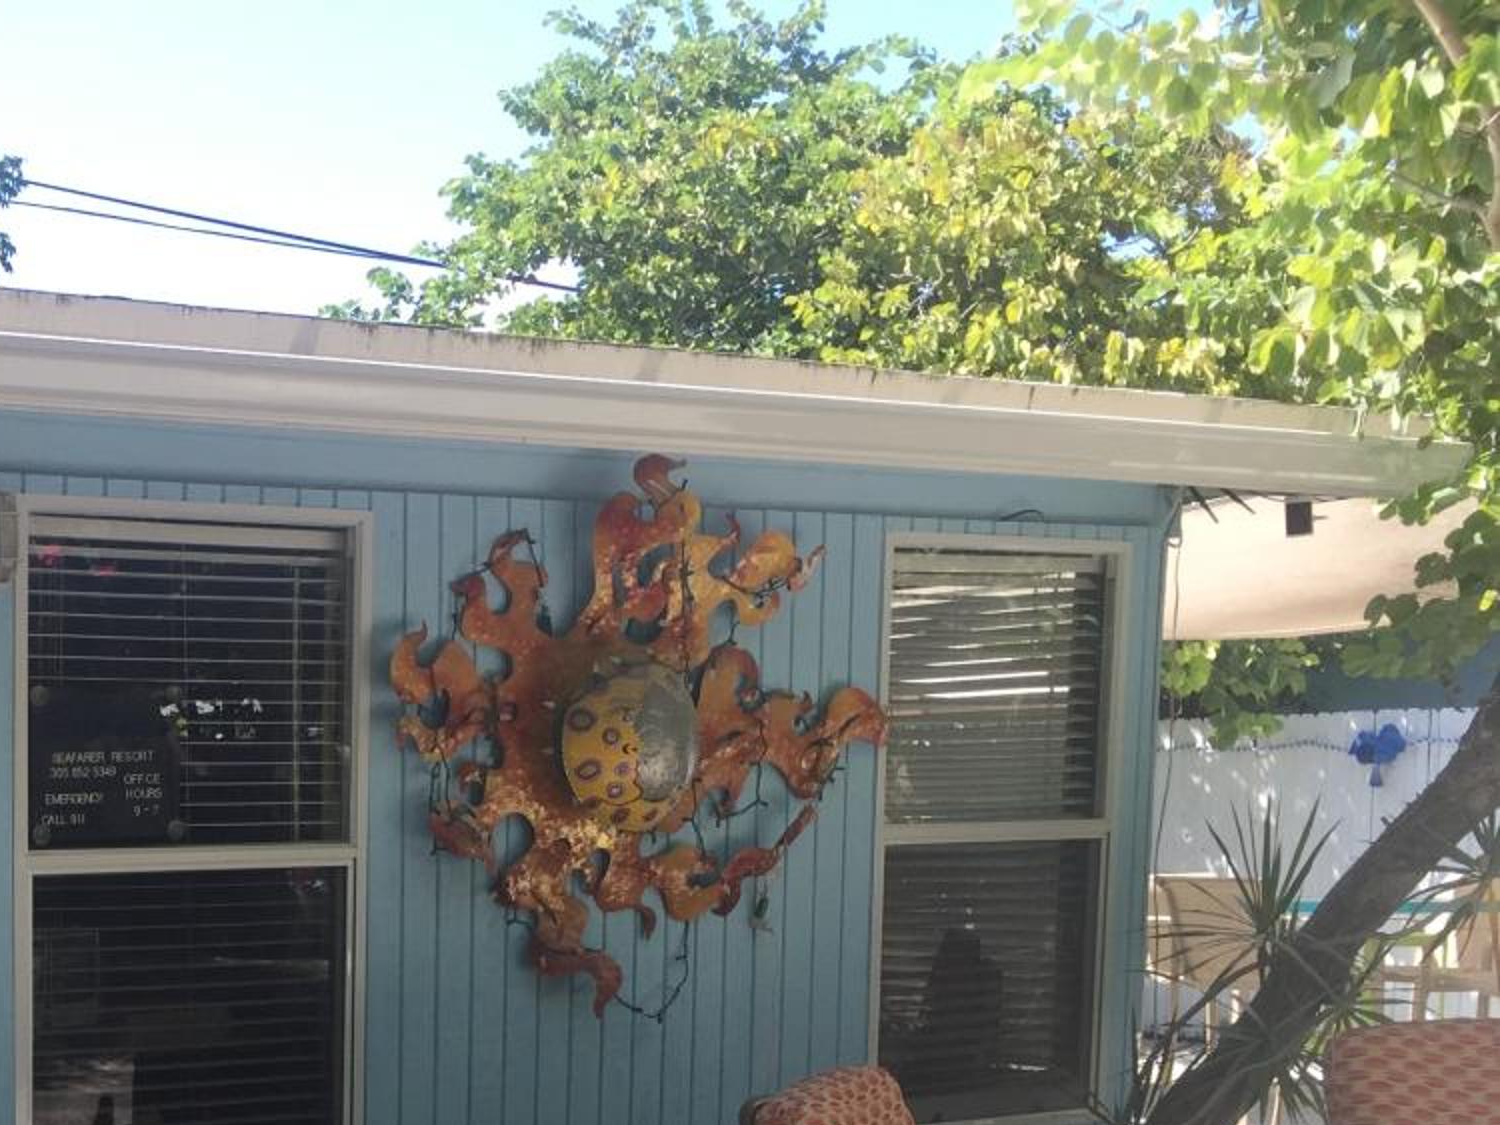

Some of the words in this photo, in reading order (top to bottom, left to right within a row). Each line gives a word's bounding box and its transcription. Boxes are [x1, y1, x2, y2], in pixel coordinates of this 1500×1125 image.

[123, 773, 161, 785] OFFICE
[45, 792, 103, 806] EMERGENCY
[125, 787, 163, 800] HOURS
[41, 814, 68, 826] CALL
